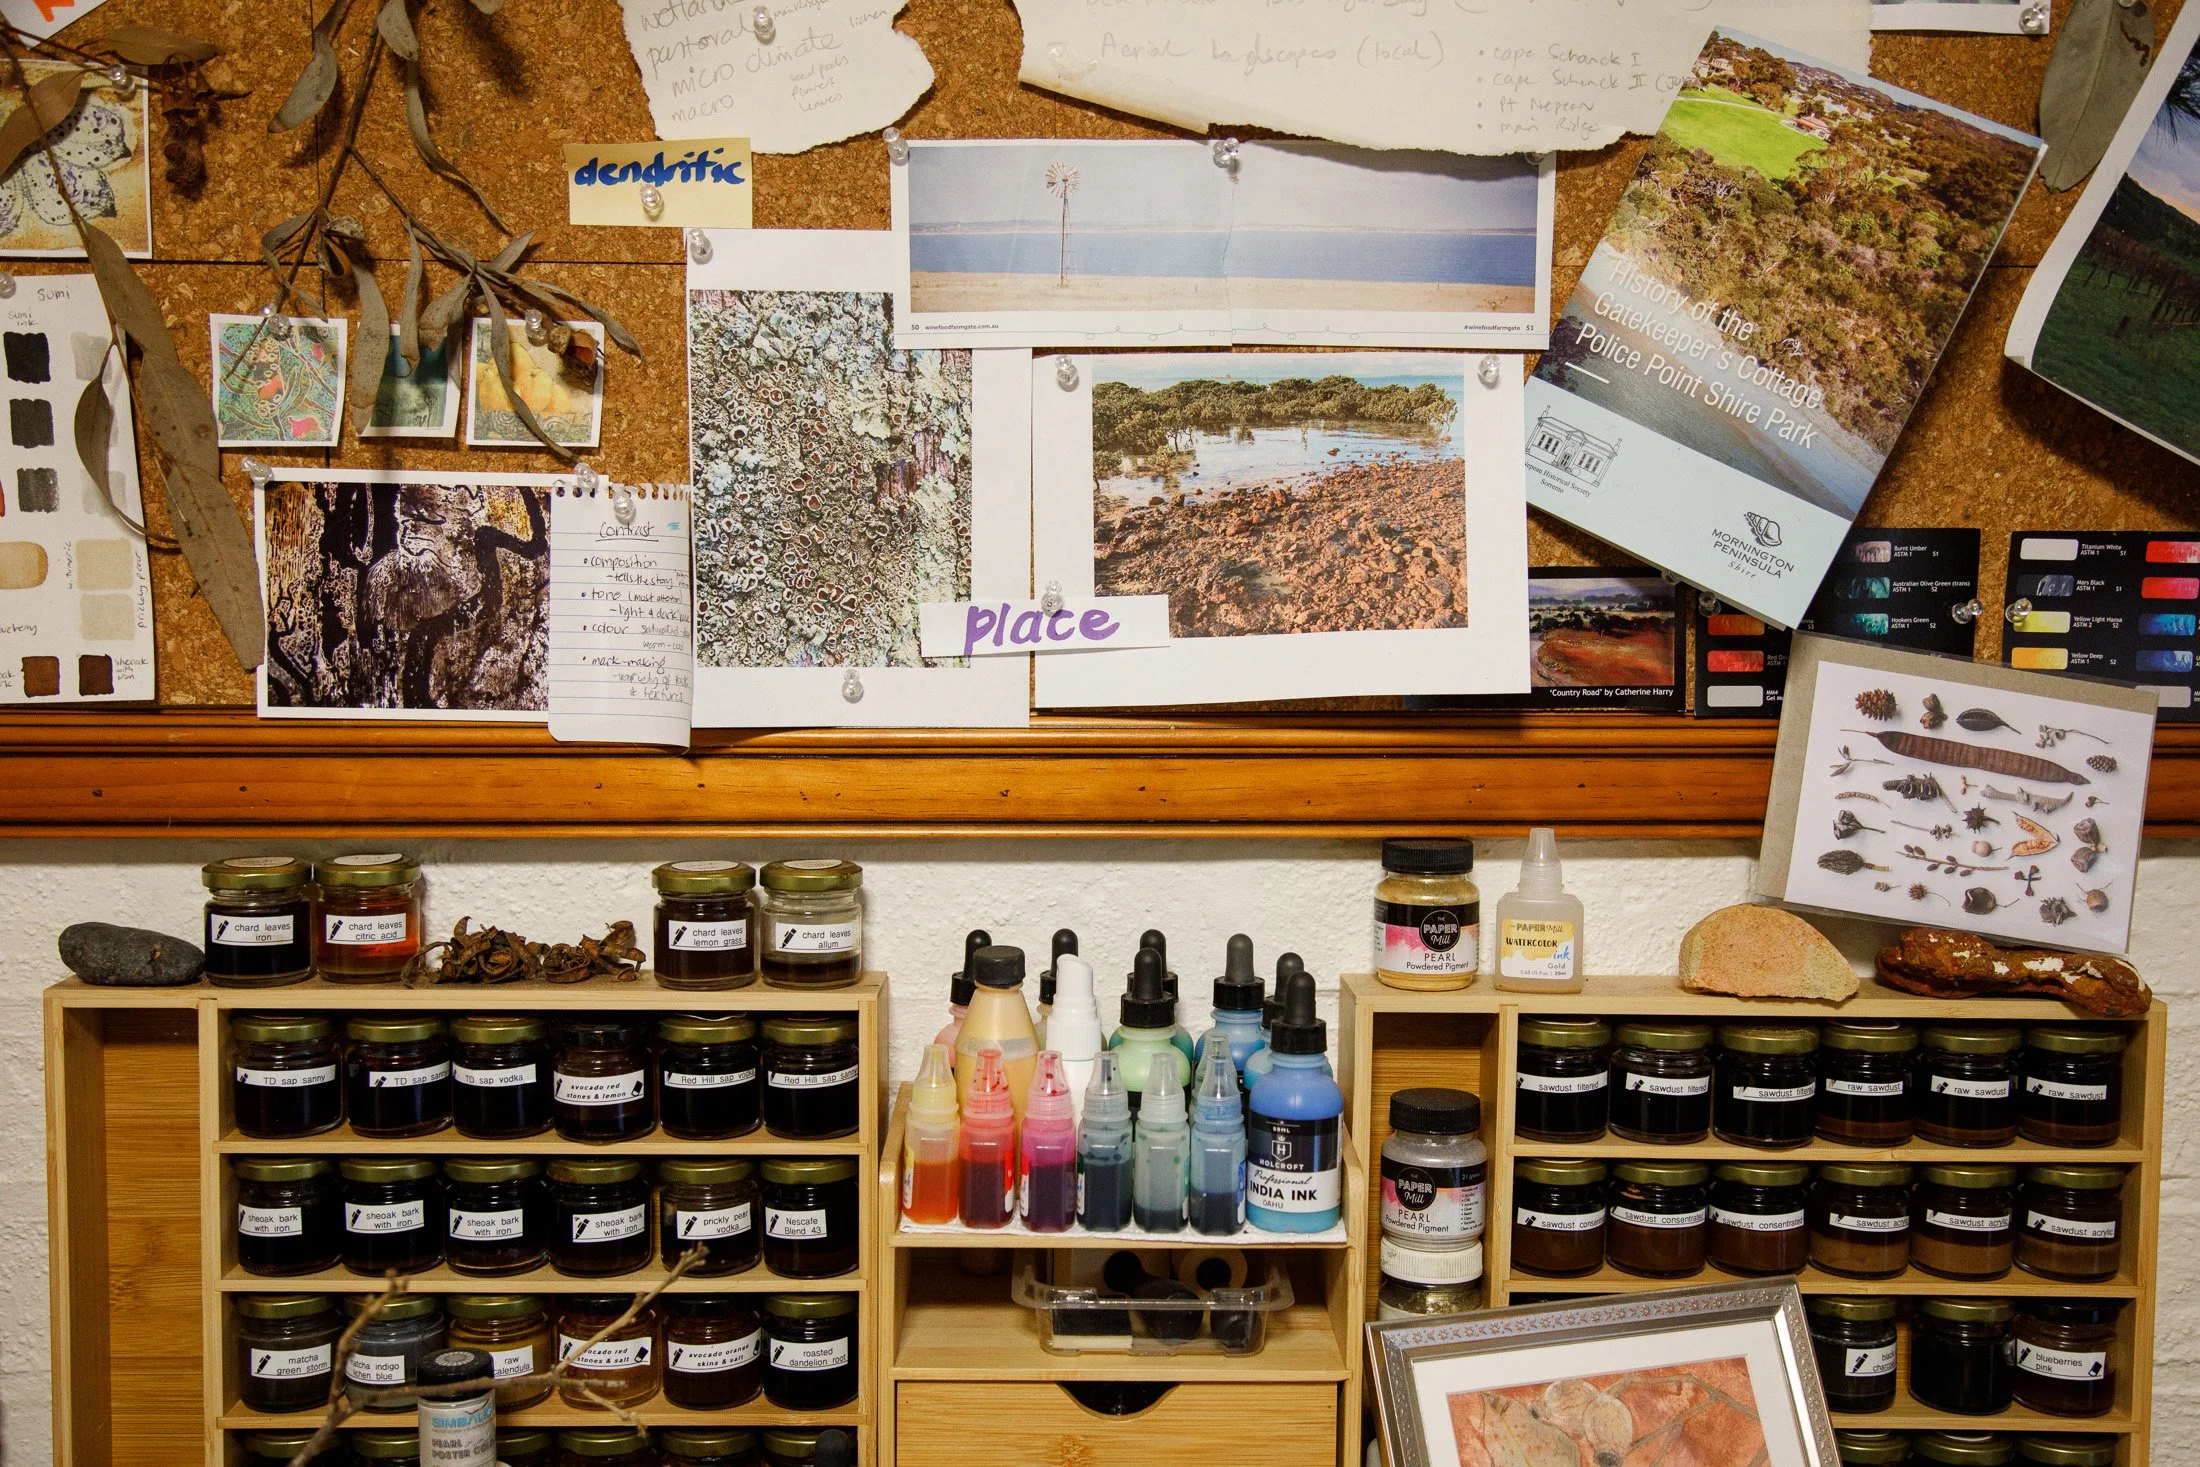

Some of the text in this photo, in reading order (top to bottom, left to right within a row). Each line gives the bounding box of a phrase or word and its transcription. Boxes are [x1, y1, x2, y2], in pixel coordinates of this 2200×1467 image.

[672, 63, 734, 97] micro
[672, 95, 733, 121] macro
[575, 148, 745, 186] dendritic
[37, 285, 70, 301] Sumi
[1608, 259, 1753, 340] History of the
[1594, 292, 1822, 409] Gatekeeper's Cottage
[1575, 322, 1818, 449] Police Point Shire Park
[1541, 479, 1564, 494] Sorrento
[1543, 470, 1570, 487] Historical
[1571, 482, 1591, 497] Society
[1712, 528, 1794, 572] MORNINGTON
[1714, 541, 1781, 578] PENINSULA
[1728, 561, 1756, 578] Shire
[963, 603, 1119, 655] place
[1615, 688, 1651, 696] Catherine
[1652, 688, 1673, 696] Harry
[235, 923, 291, 932] chard leaves
[349, 921, 403, 931] chard leaves
[1423, 924, 1457, 933] PAPER
[1517, 923, 1563, 933] PAPER Mill
[356, 931, 397, 940] citric acid
[693, 928, 743, 937] chard leaves
[830, 930, 851, 938] leaves
[694, 937, 742, 947] lemon grass
[819, 941, 838, 949] allum
[1431, 935, 1450, 945] Mill
[1506, 937, 1557, 947] WATERCOLOR
[1425, 953, 1455, 961] PEARL
[1553, 946, 1570, 960] ink
[1407, 962, 1468, 971] Powdered Pigment
[263, 1075, 326, 1086] TD sap sanny
[465, 1073, 523, 1085] TD sap vodka
[682, 1076, 697, 1085] Red
[701, 1076, 714, 1084] Hill
[720, 1074, 734, 1084] sap
[1539, 1081, 1599, 1091] sawdust filtered
[1975, 1087, 2006, 1096] sawdust
[1260, 1159, 1304, 1170] HOLCROFT
[1254, 1170, 1312, 1185] Professional
[1250, 1181, 1317, 1200] INDIA INK
[1398, 1179, 1432, 1193] PAPER
[1405, 1192, 1424, 1204] Mill
[1263, 1200, 1283, 1208] OAHU
[366, 1207, 420, 1220] sheoak bark
[703, 1210, 748, 1226] prickly pear
[1398, 1209, 1430, 1222] PEARL
[374, 1218, 412, 1229] with iron
[786, 1217, 818, 1225] Nescafe
[1386, 1215, 1449, 1233] Powdered Pigment
[1722, 1218, 1754, 1228] sawdust
[716, 1223, 740, 1234] vodka
[784, 1226, 821, 1235] Blend 43
[2051, 1225, 2113, 1237] sawdust acrylic
[726, 1344, 749, 1353] orange
[803, 1348, 833, 1357] roasted
[289, 1354, 318, 1364] matcha
[504, 1355, 519, 1364] raw
[790, 1355, 846, 1366] dandelion root
[2036, 1353, 2082, 1367] blueberries
[276, 1362, 328, 1376] green storm
[494, 1364, 530, 1376] calendula
[2035, 1363, 2052, 1373] pink
